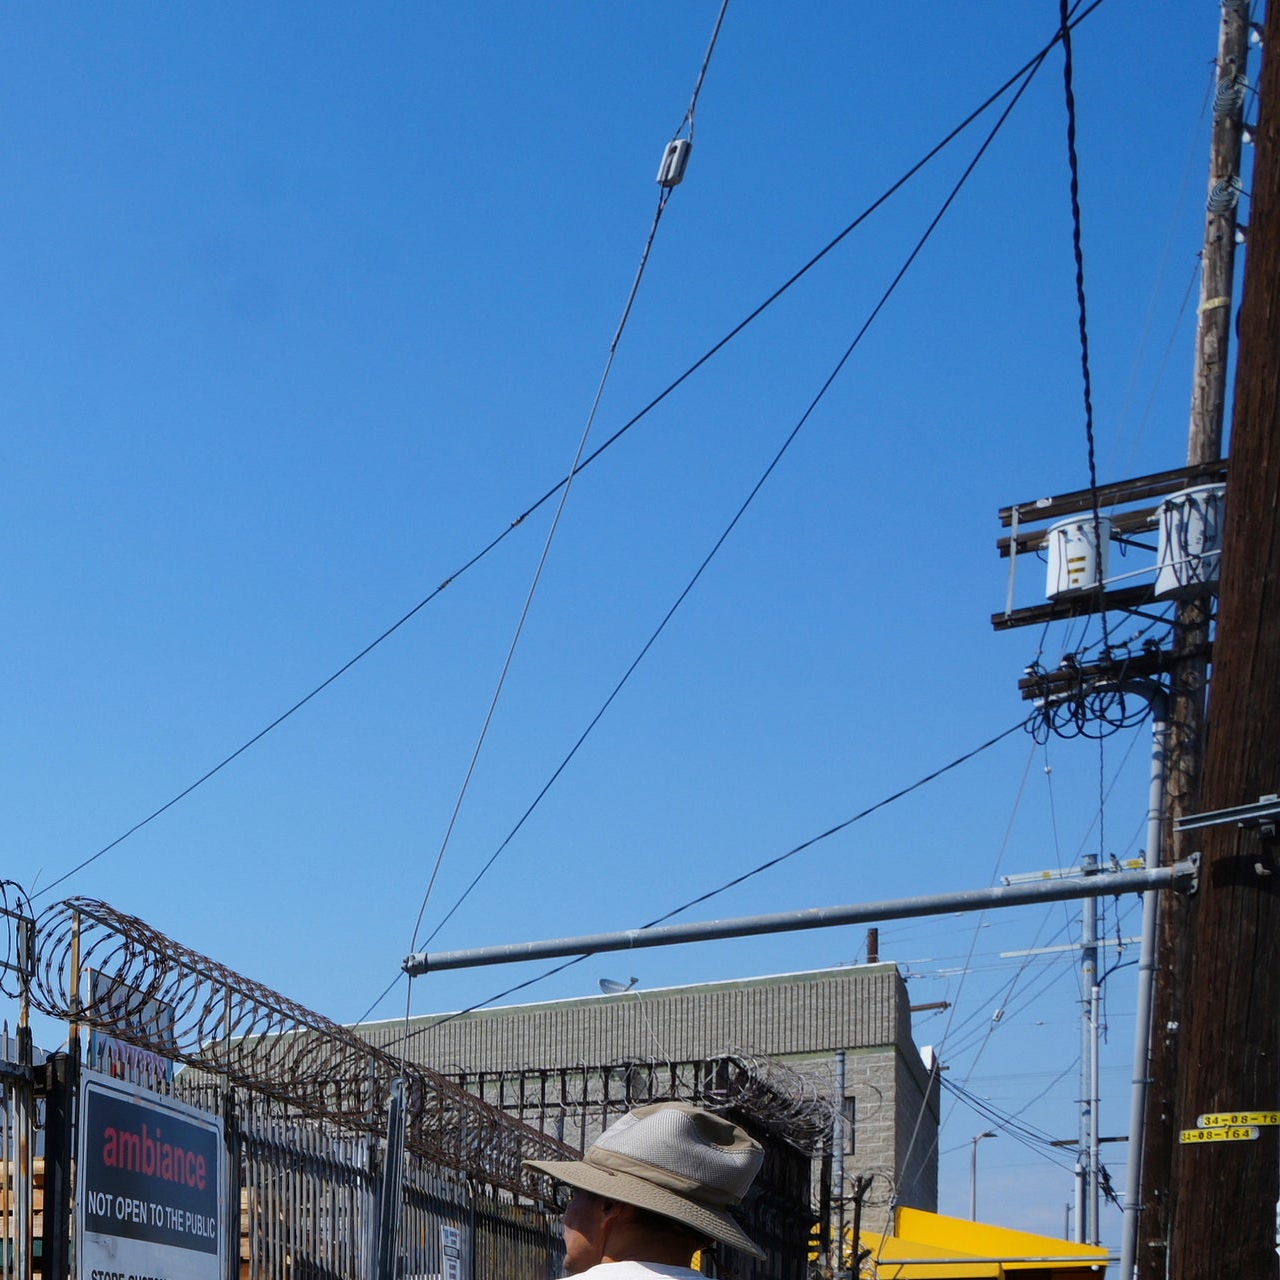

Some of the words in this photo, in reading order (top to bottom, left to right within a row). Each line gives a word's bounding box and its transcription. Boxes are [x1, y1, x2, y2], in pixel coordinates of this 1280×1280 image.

[103, 1123, 207, 1191] ambiance
[1182, 1129, 1250, 1142] 34-08-164
[88, 1190, 113, 1217] NOT
[115, 1196, 147, 1224] OPEN
[150, 1203, 164, 1227] TO
[166, 1206, 184, 1231] THE
[185, 1211, 216, 1239] PUBLIC
